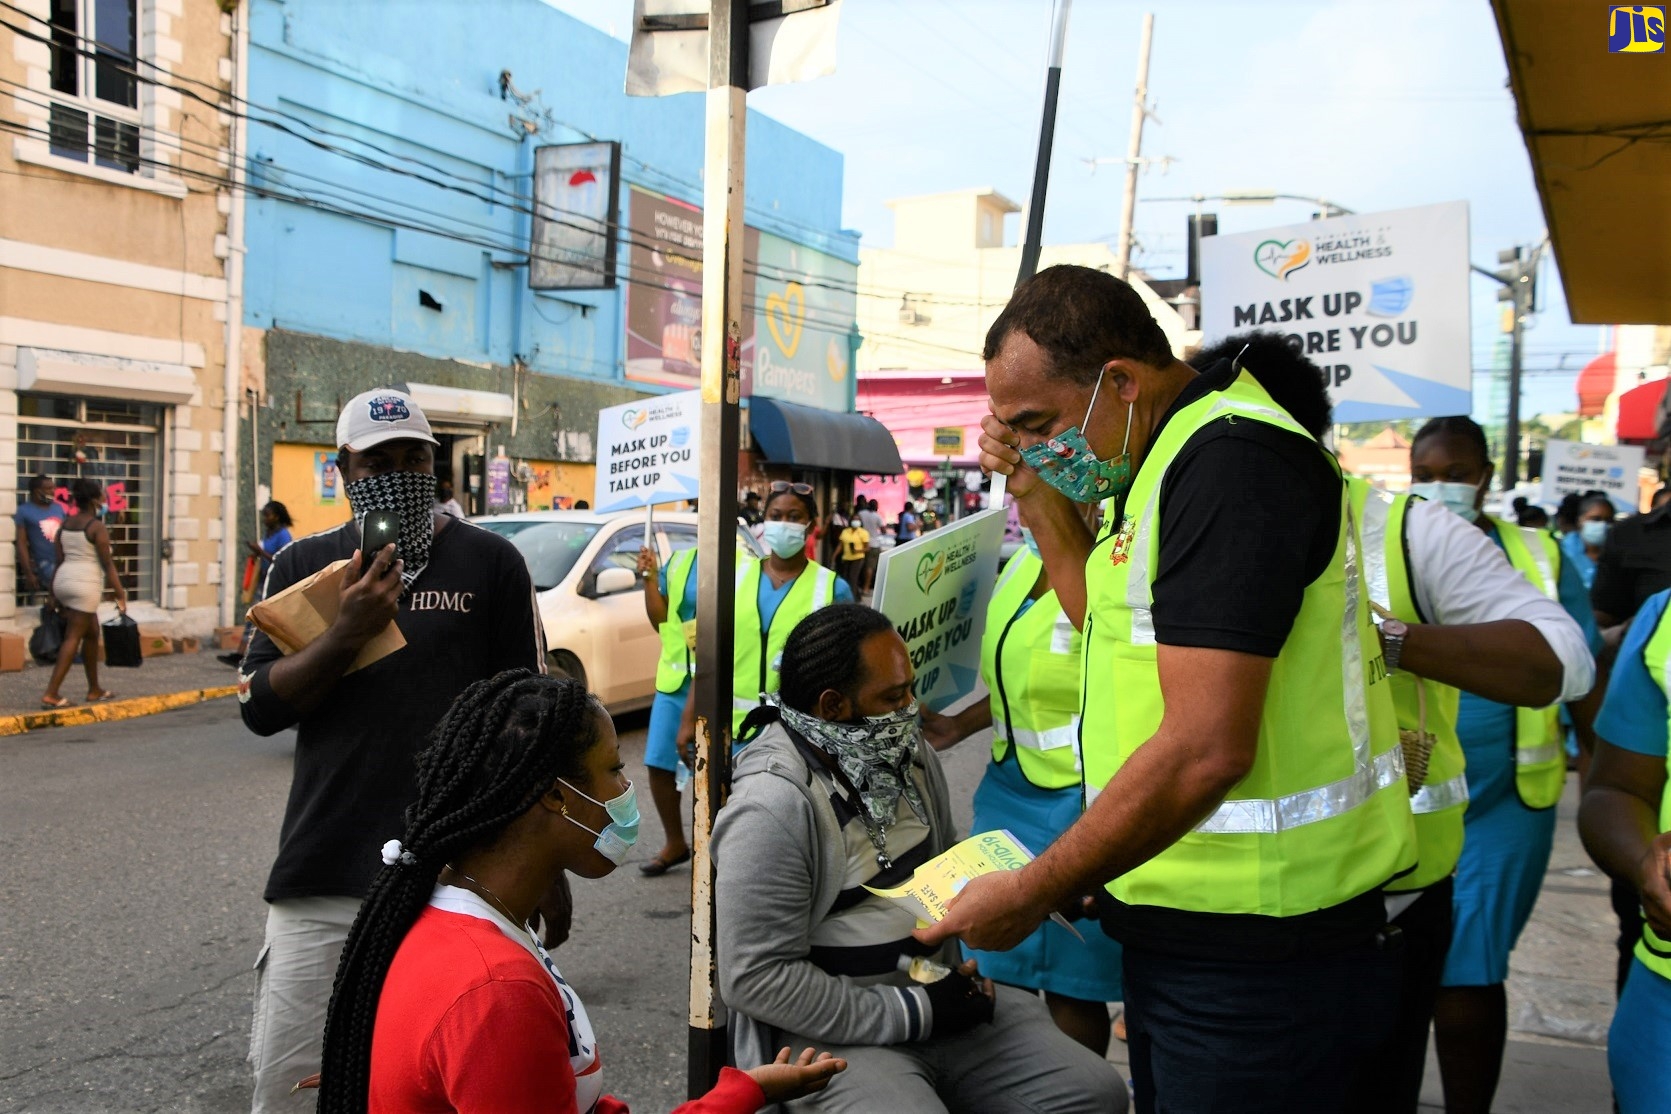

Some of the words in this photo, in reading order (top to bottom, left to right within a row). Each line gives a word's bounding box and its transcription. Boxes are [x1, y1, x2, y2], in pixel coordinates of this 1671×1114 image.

[1315, 236, 1370, 252] HEALTH
[1315, 246, 1393, 265] WELLNESS
[1233, 295, 1314, 328] MASK
[1322, 291, 1362, 317] UP
[1284, 328, 1340, 354] ORE
[1349, 320, 1418, 349] YOU
[758, 346, 816, 396] Pampers
[611, 438, 646, 457] MASK
[650, 434, 668, 448] UP
[610, 454, 657, 475] BEFORE
[661, 448, 691, 464] YOU
[609, 476, 639, 493] TALK
[643, 472, 661, 486] UP
[944, 551, 977, 575] WELLNESS
[945, 544, 971, 562] HEALTH
[410, 591, 473, 613] HDMC
[897, 606, 937, 643] MASK
[938, 597, 957, 626] UP
[944, 617, 973, 652] YOU
[921, 666, 940, 695] UP
[982, 836, 1024, 870] OVID-19
[920, 884, 938, 902] SAFE
